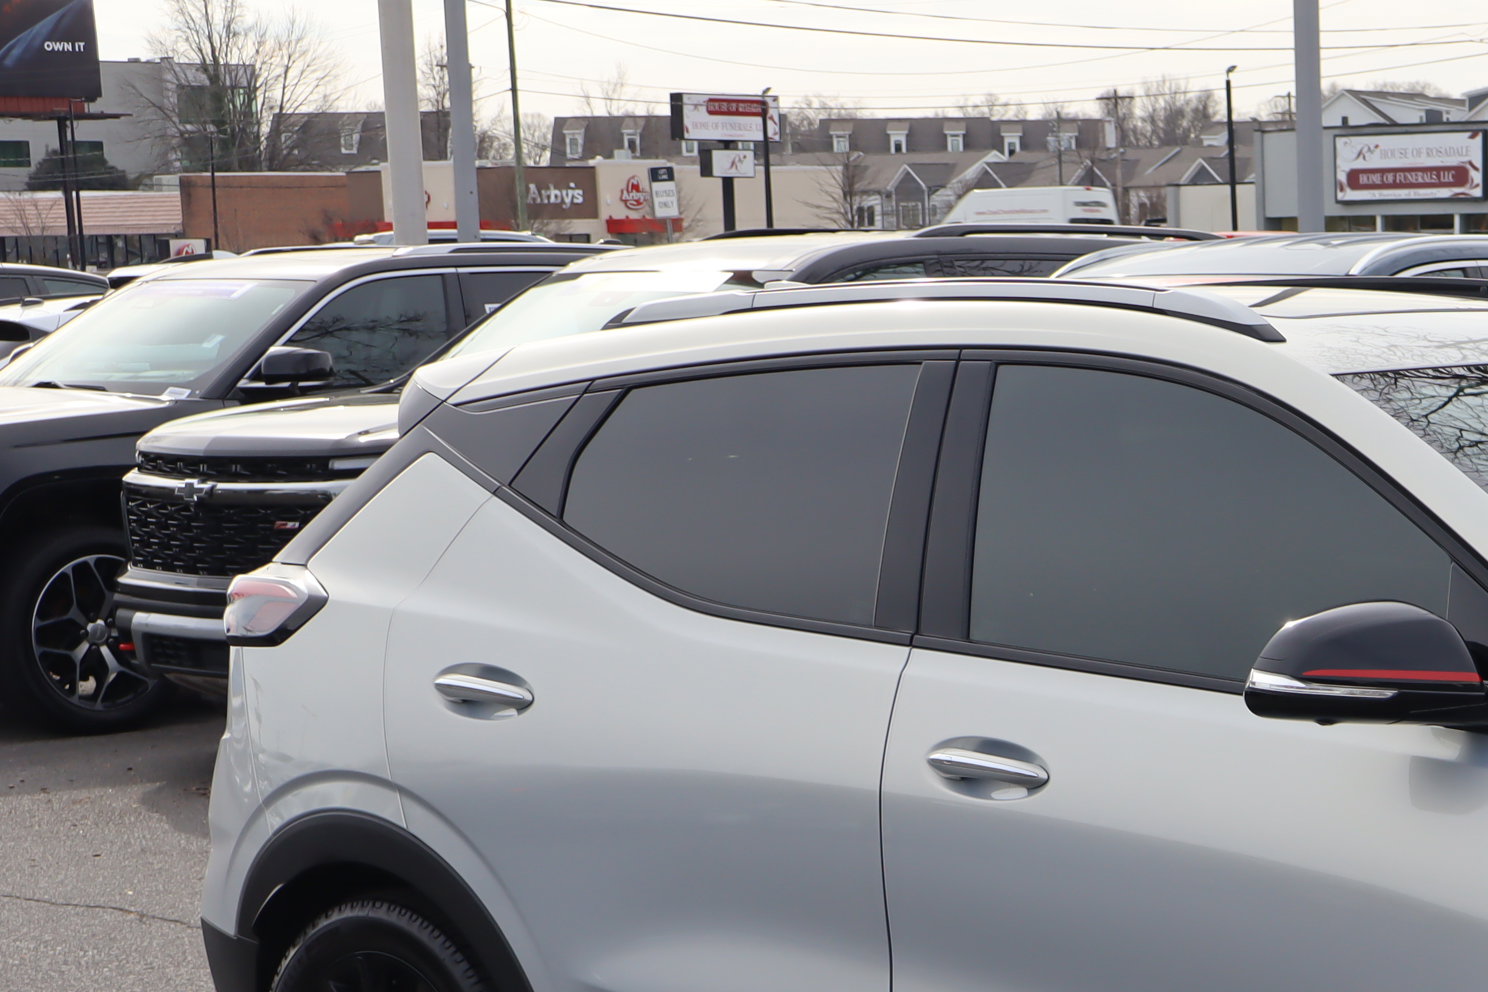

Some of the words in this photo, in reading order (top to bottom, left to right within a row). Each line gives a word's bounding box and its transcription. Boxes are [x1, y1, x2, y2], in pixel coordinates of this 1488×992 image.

[44, 41, 72, 52] OWN
[75, 42, 85, 52] IT
[1380, 147, 1409, 160] HOUSE
[1411, 147, 1424, 159] OF
[1425, 144, 1472, 158] ROSADALE
[1359, 173, 1383, 184] HOME
[1384, 172, 1396, 184] OF
[1440, 171, 1456, 182] LLC
[528, 182, 583, 209] Arby's
[655, 189, 675, 198] BUSES
[658, 201, 674, 209] ONLY
